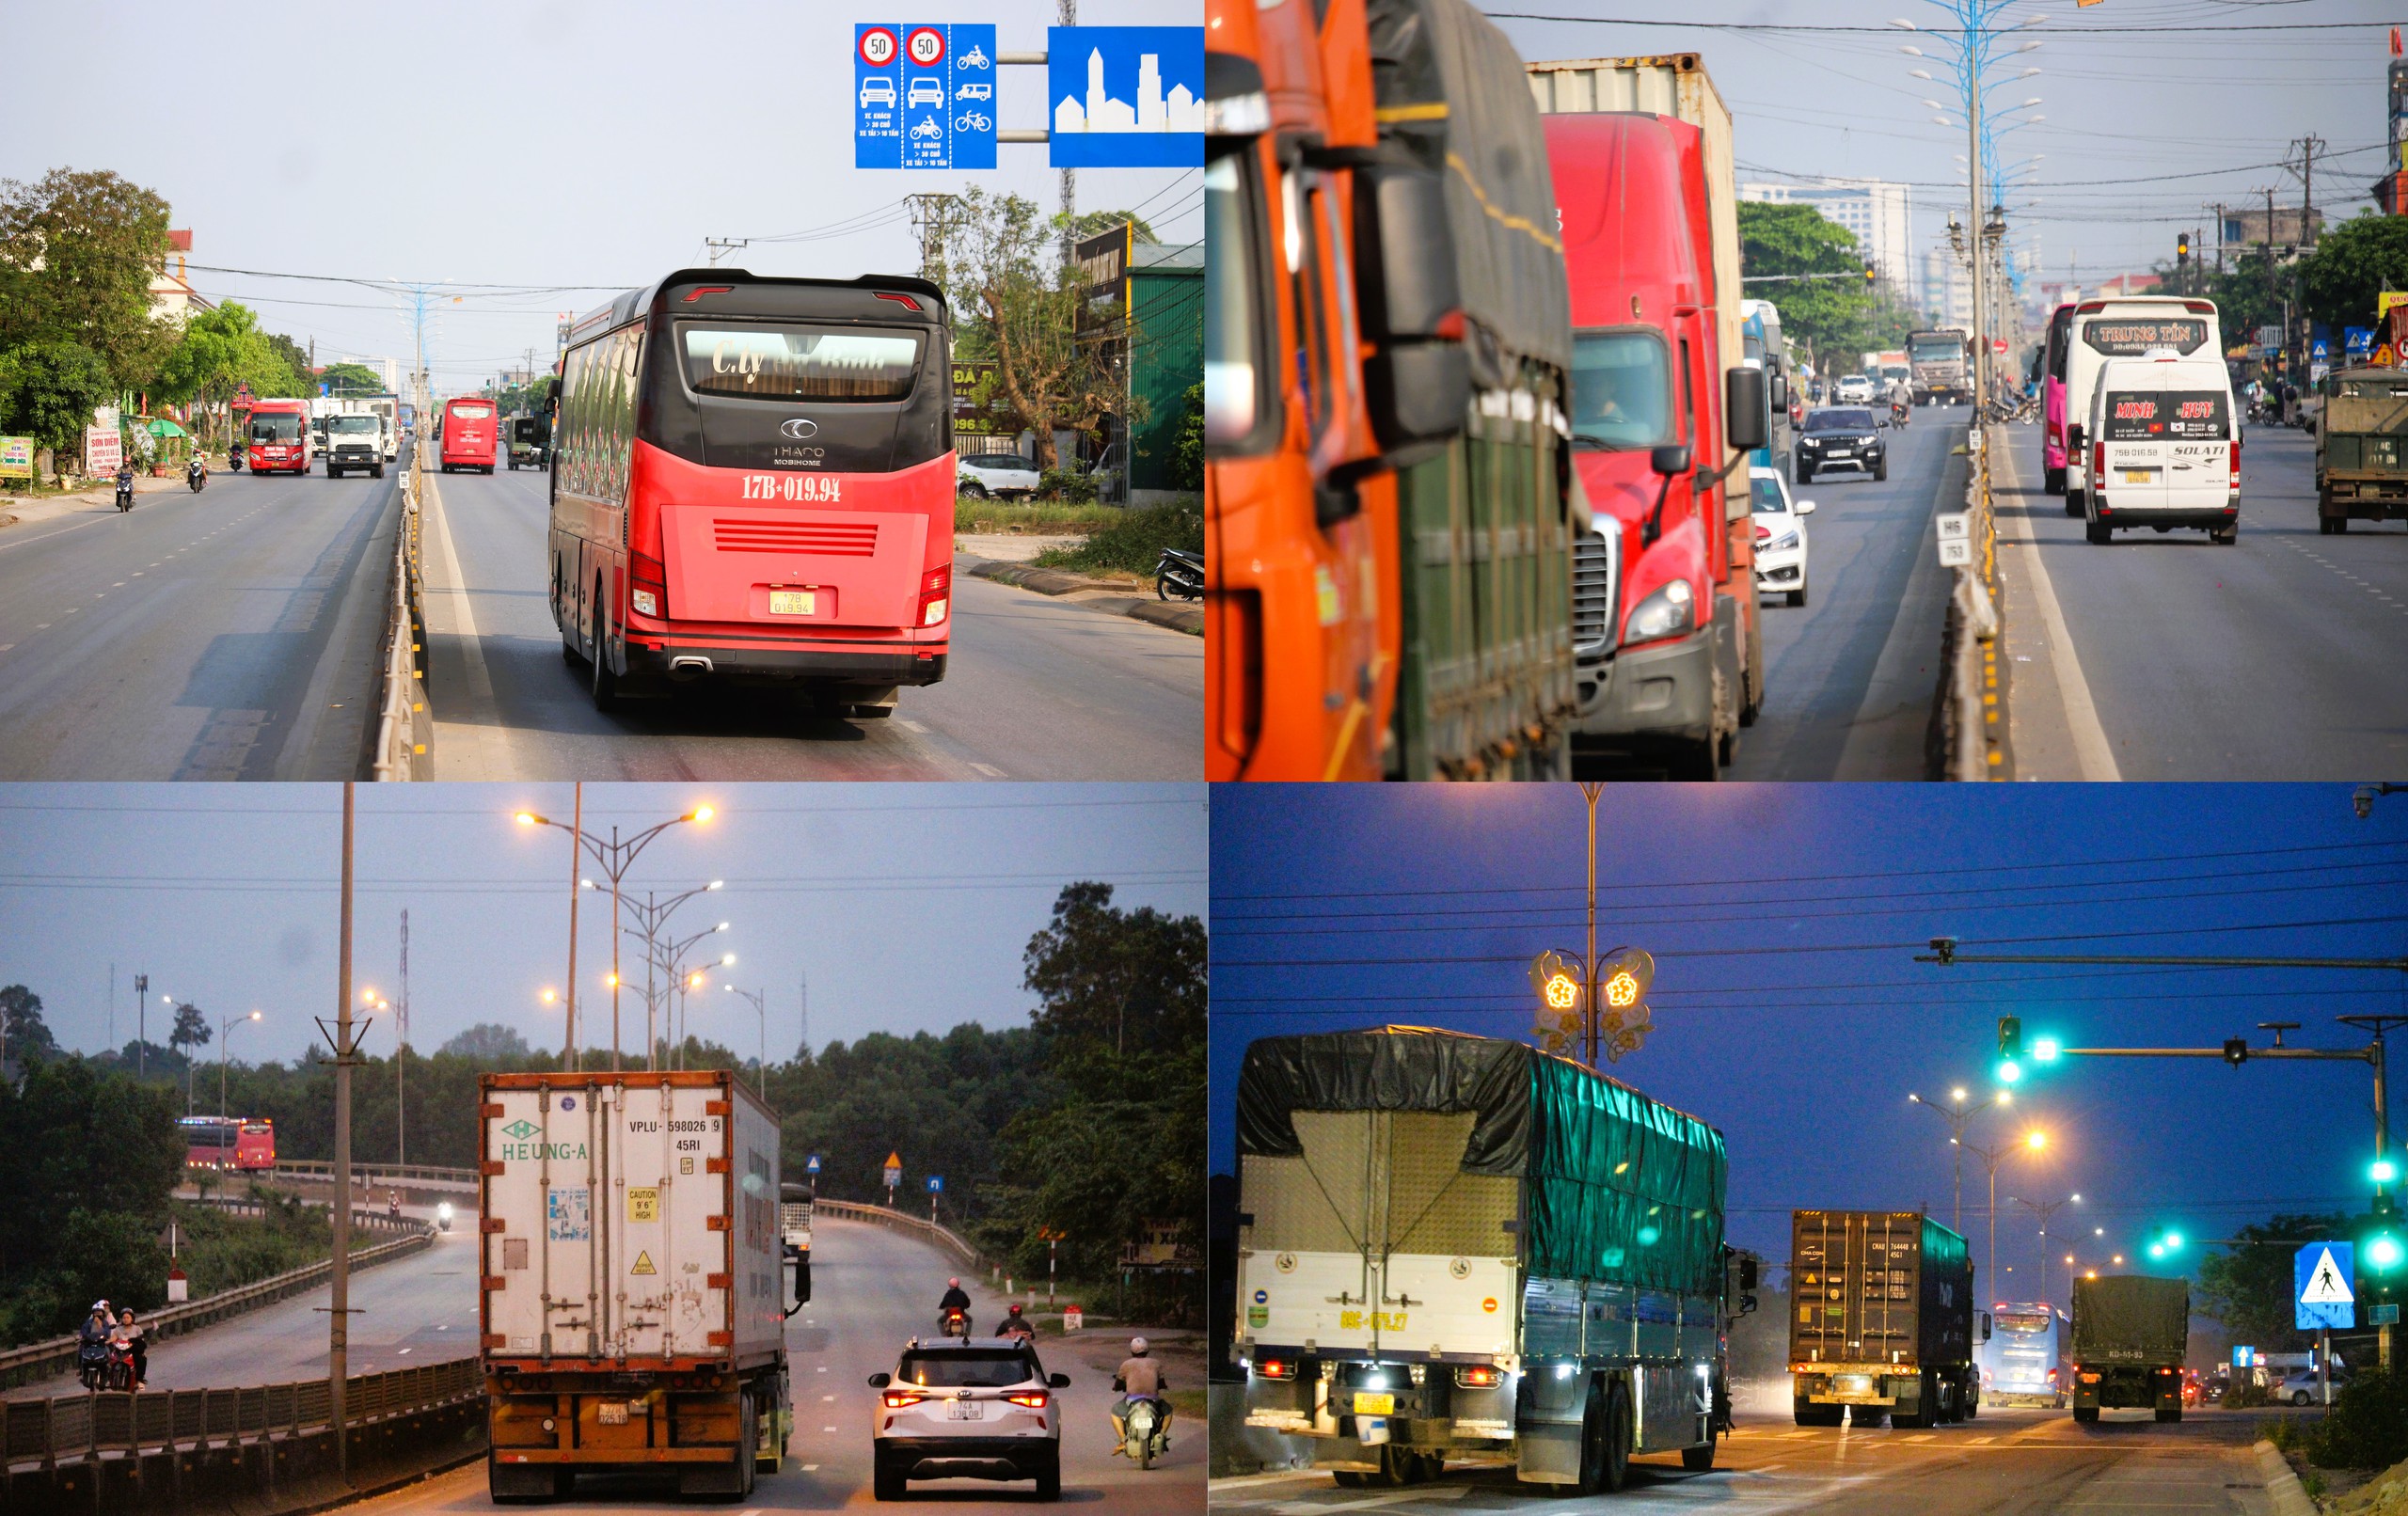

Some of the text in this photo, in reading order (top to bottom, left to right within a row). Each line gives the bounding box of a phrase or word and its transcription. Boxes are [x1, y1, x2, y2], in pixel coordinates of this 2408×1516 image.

[871, 39, 886, 55] 50
[918, 39, 933, 55] 50
[2099, 323, 2191, 342] TRUNG TÍN
[952, 368, 976, 384] ĐÁ
[2115, 402, 2214, 418] MINH HUY
[2174, 446, 2226, 455] SOLATI
[1944, 521, 1961, 535] H6
[783, 593, 801, 603] 17B
[774, 603, 809, 613] 019.94
[669, 1121, 706, 1132] 598026
[712, 1120, 721, 1132] 9
[502, 1143, 588, 1161] HEUNG-A
[629, 1191, 657, 1199] CAUTION
[958, 1401, 973, 1410] 74A
